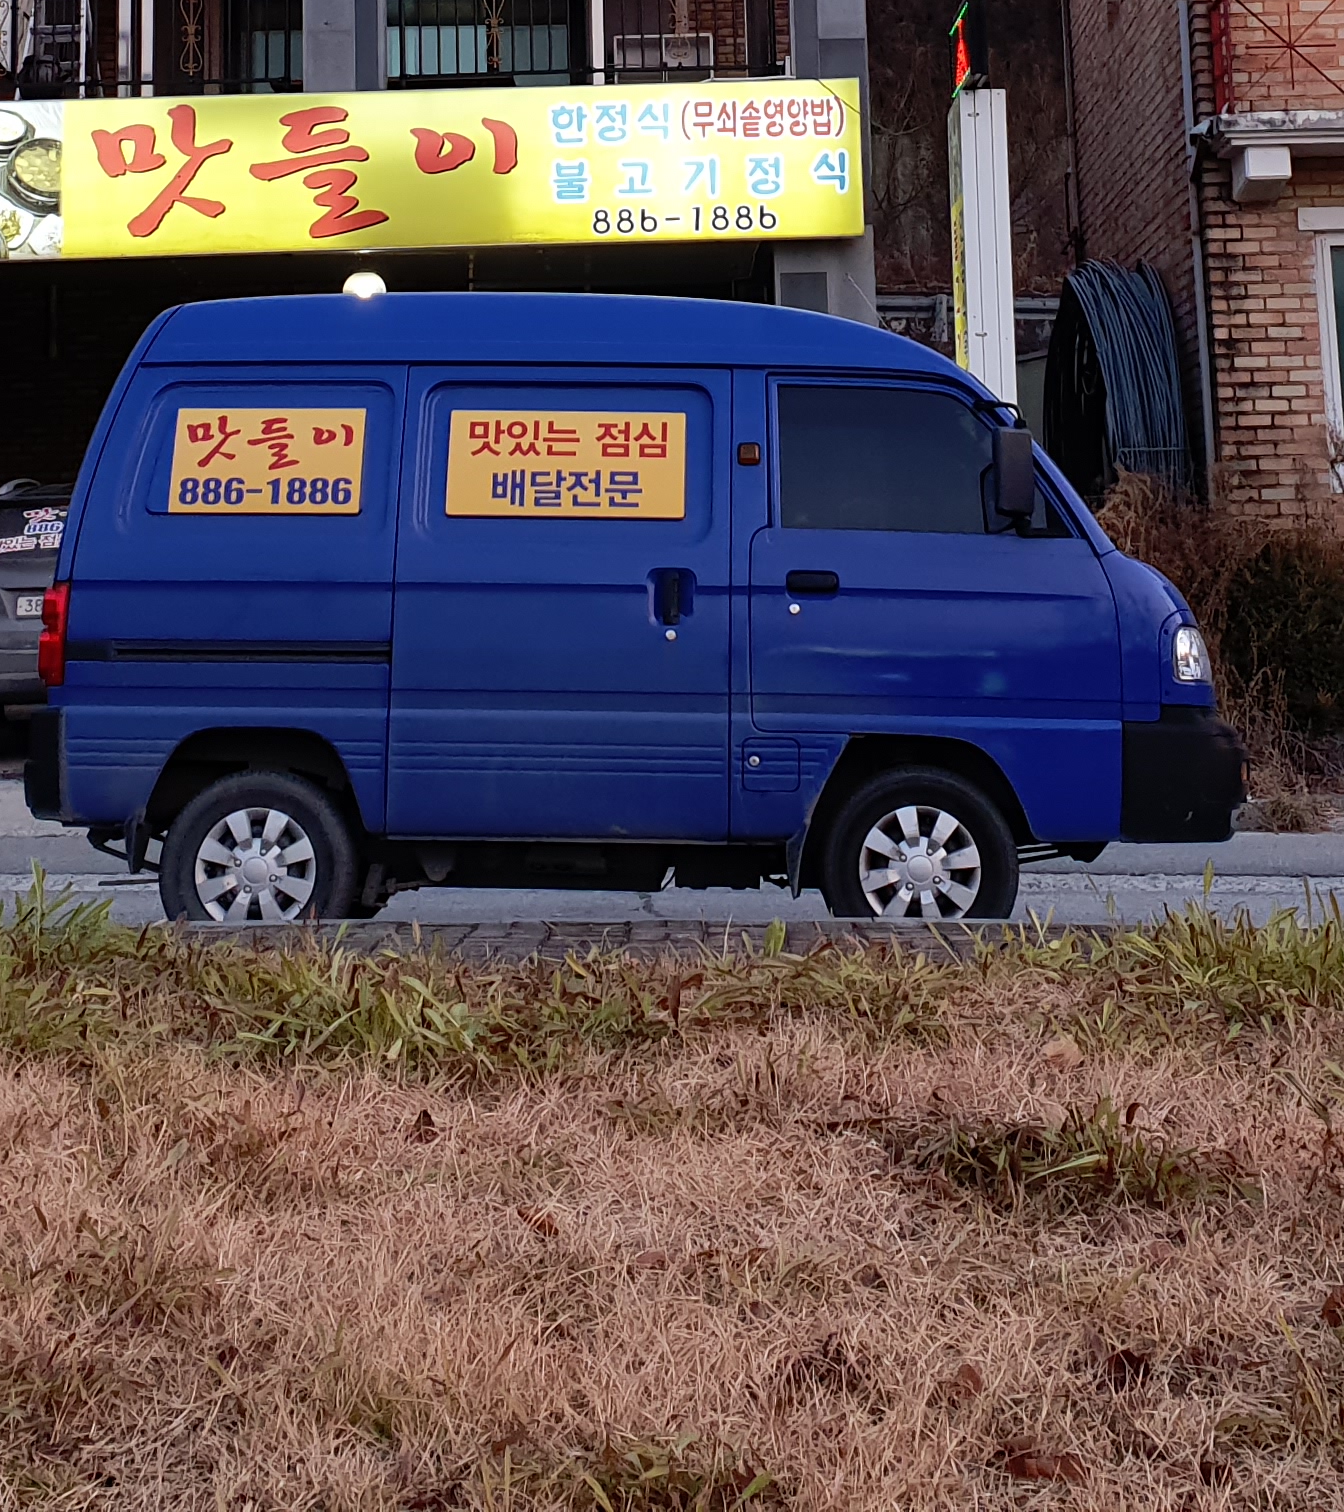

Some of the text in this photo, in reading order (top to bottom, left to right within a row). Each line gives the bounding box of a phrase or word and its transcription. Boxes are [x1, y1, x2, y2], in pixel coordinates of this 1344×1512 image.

[551, 103, 670, 144] 한정식
[89, 102, 520, 240] 맛들이
[553, 152, 847, 200] 불고기정식
[592, 205, 777, 234] 886-1886
[186, 414, 355, 472] 맛들이
[468, 420, 670, 459] 맛있는 점심
[177, 476, 353, 507] 886-1886
[491, 469, 644, 509] 배달전문
